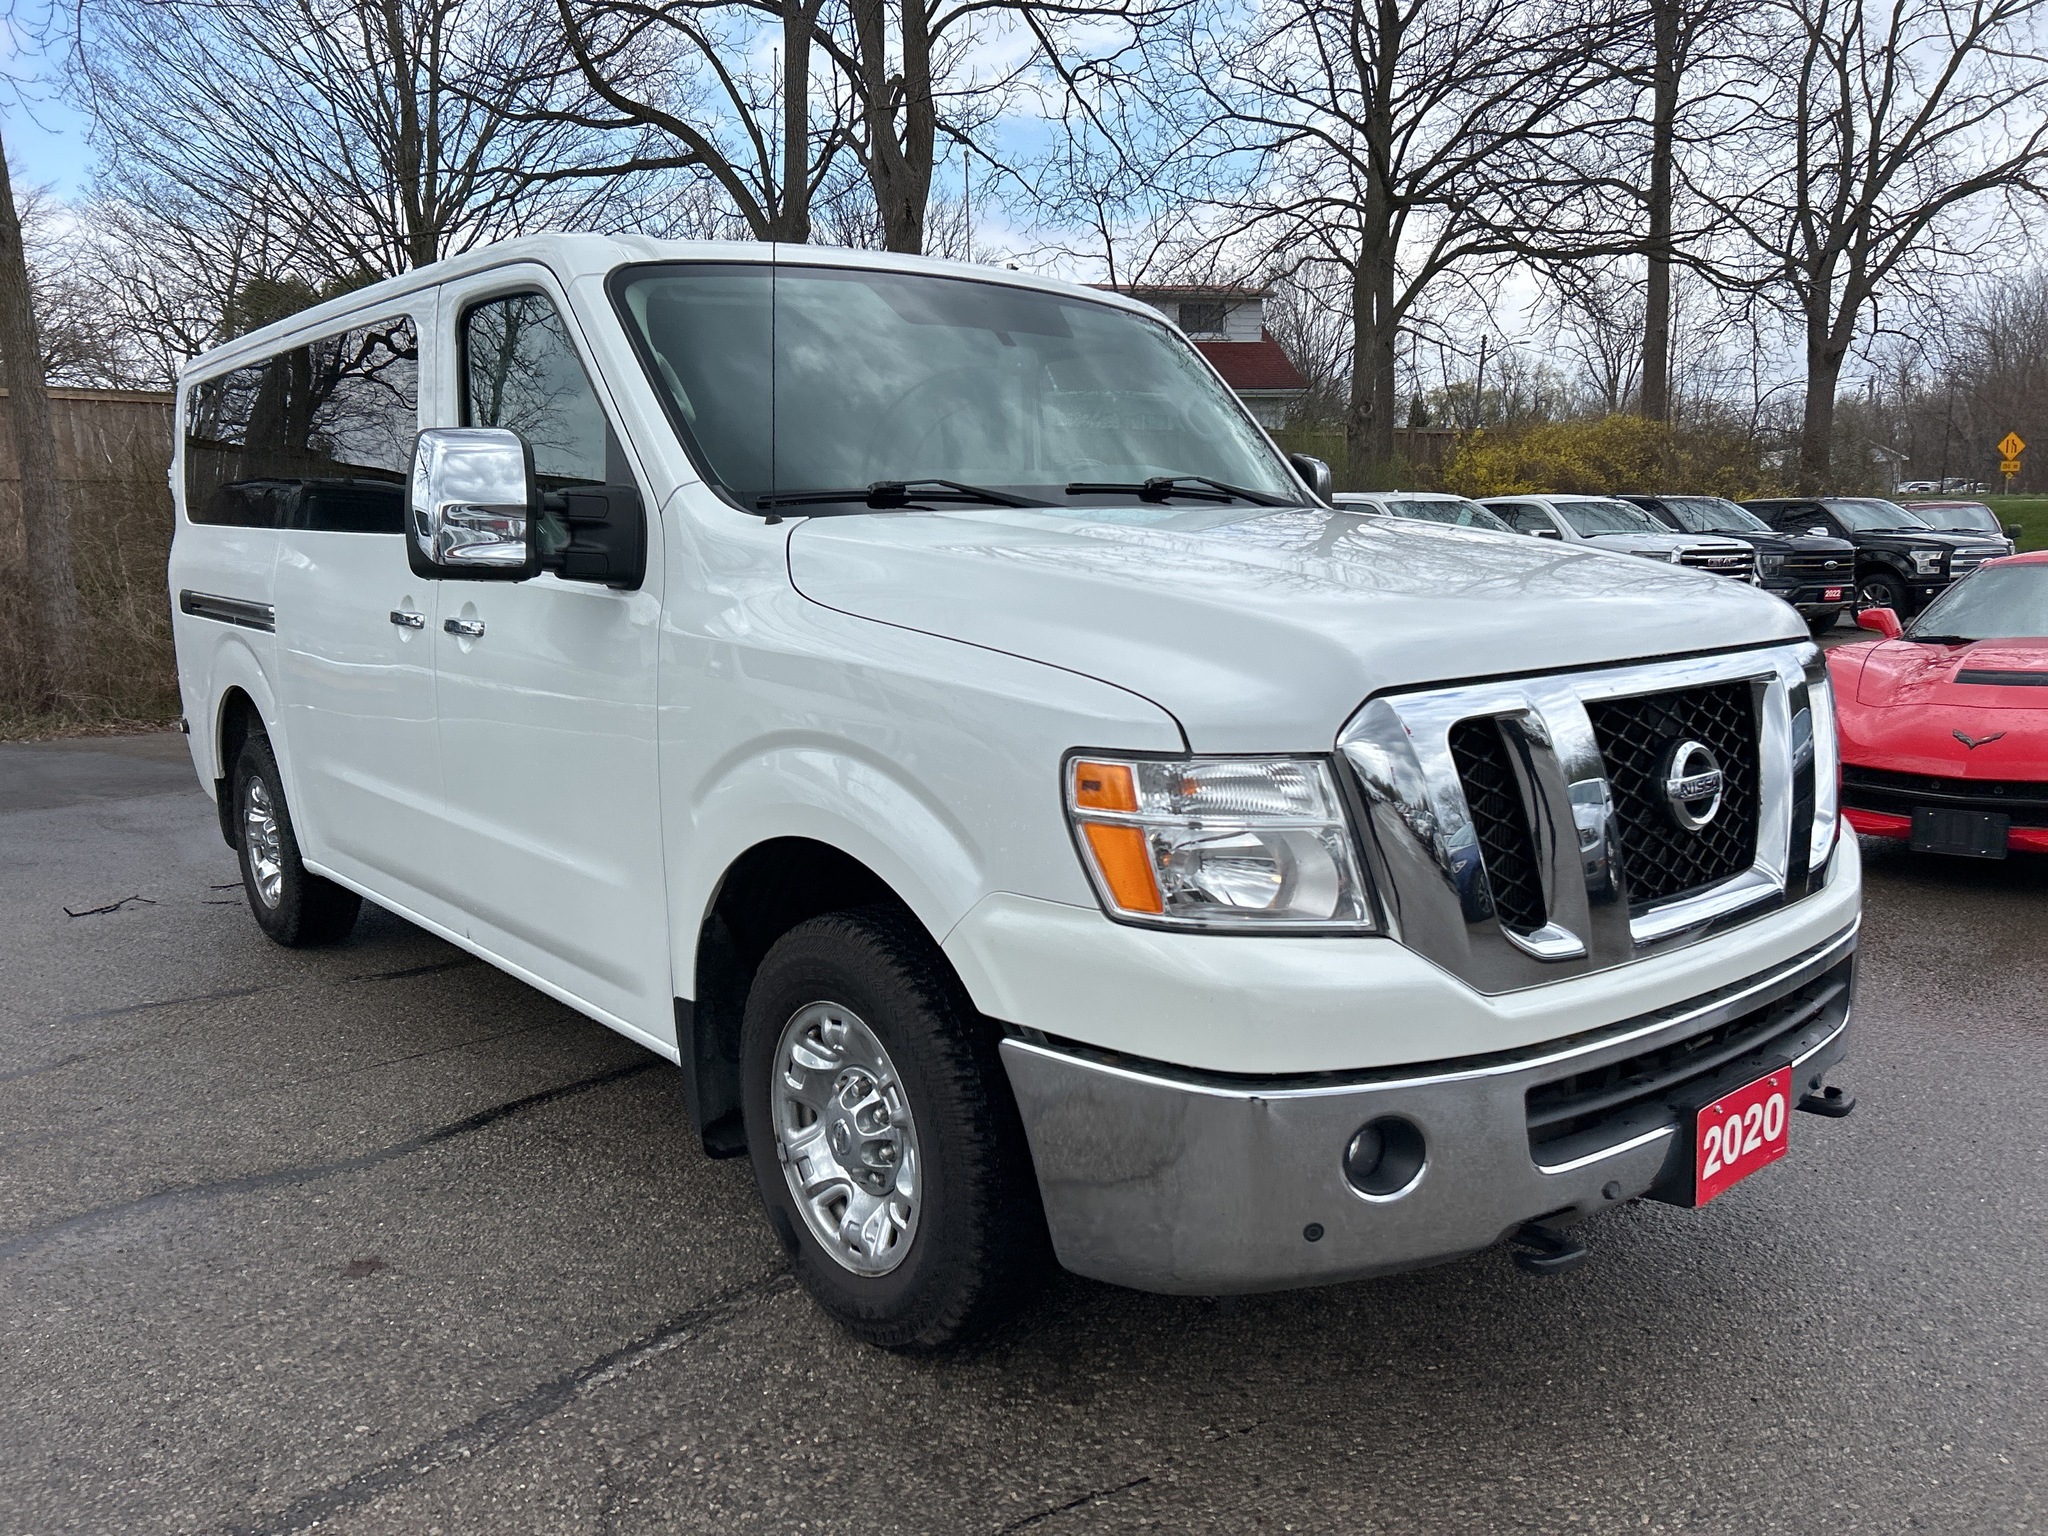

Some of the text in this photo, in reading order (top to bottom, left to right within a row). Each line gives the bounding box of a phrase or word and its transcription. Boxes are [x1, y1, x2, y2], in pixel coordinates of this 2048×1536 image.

[1824, 589, 1841, 598] 2022
[1680, 775, 1719, 797] NISSA
[1703, 1093, 1784, 1180] 2020
